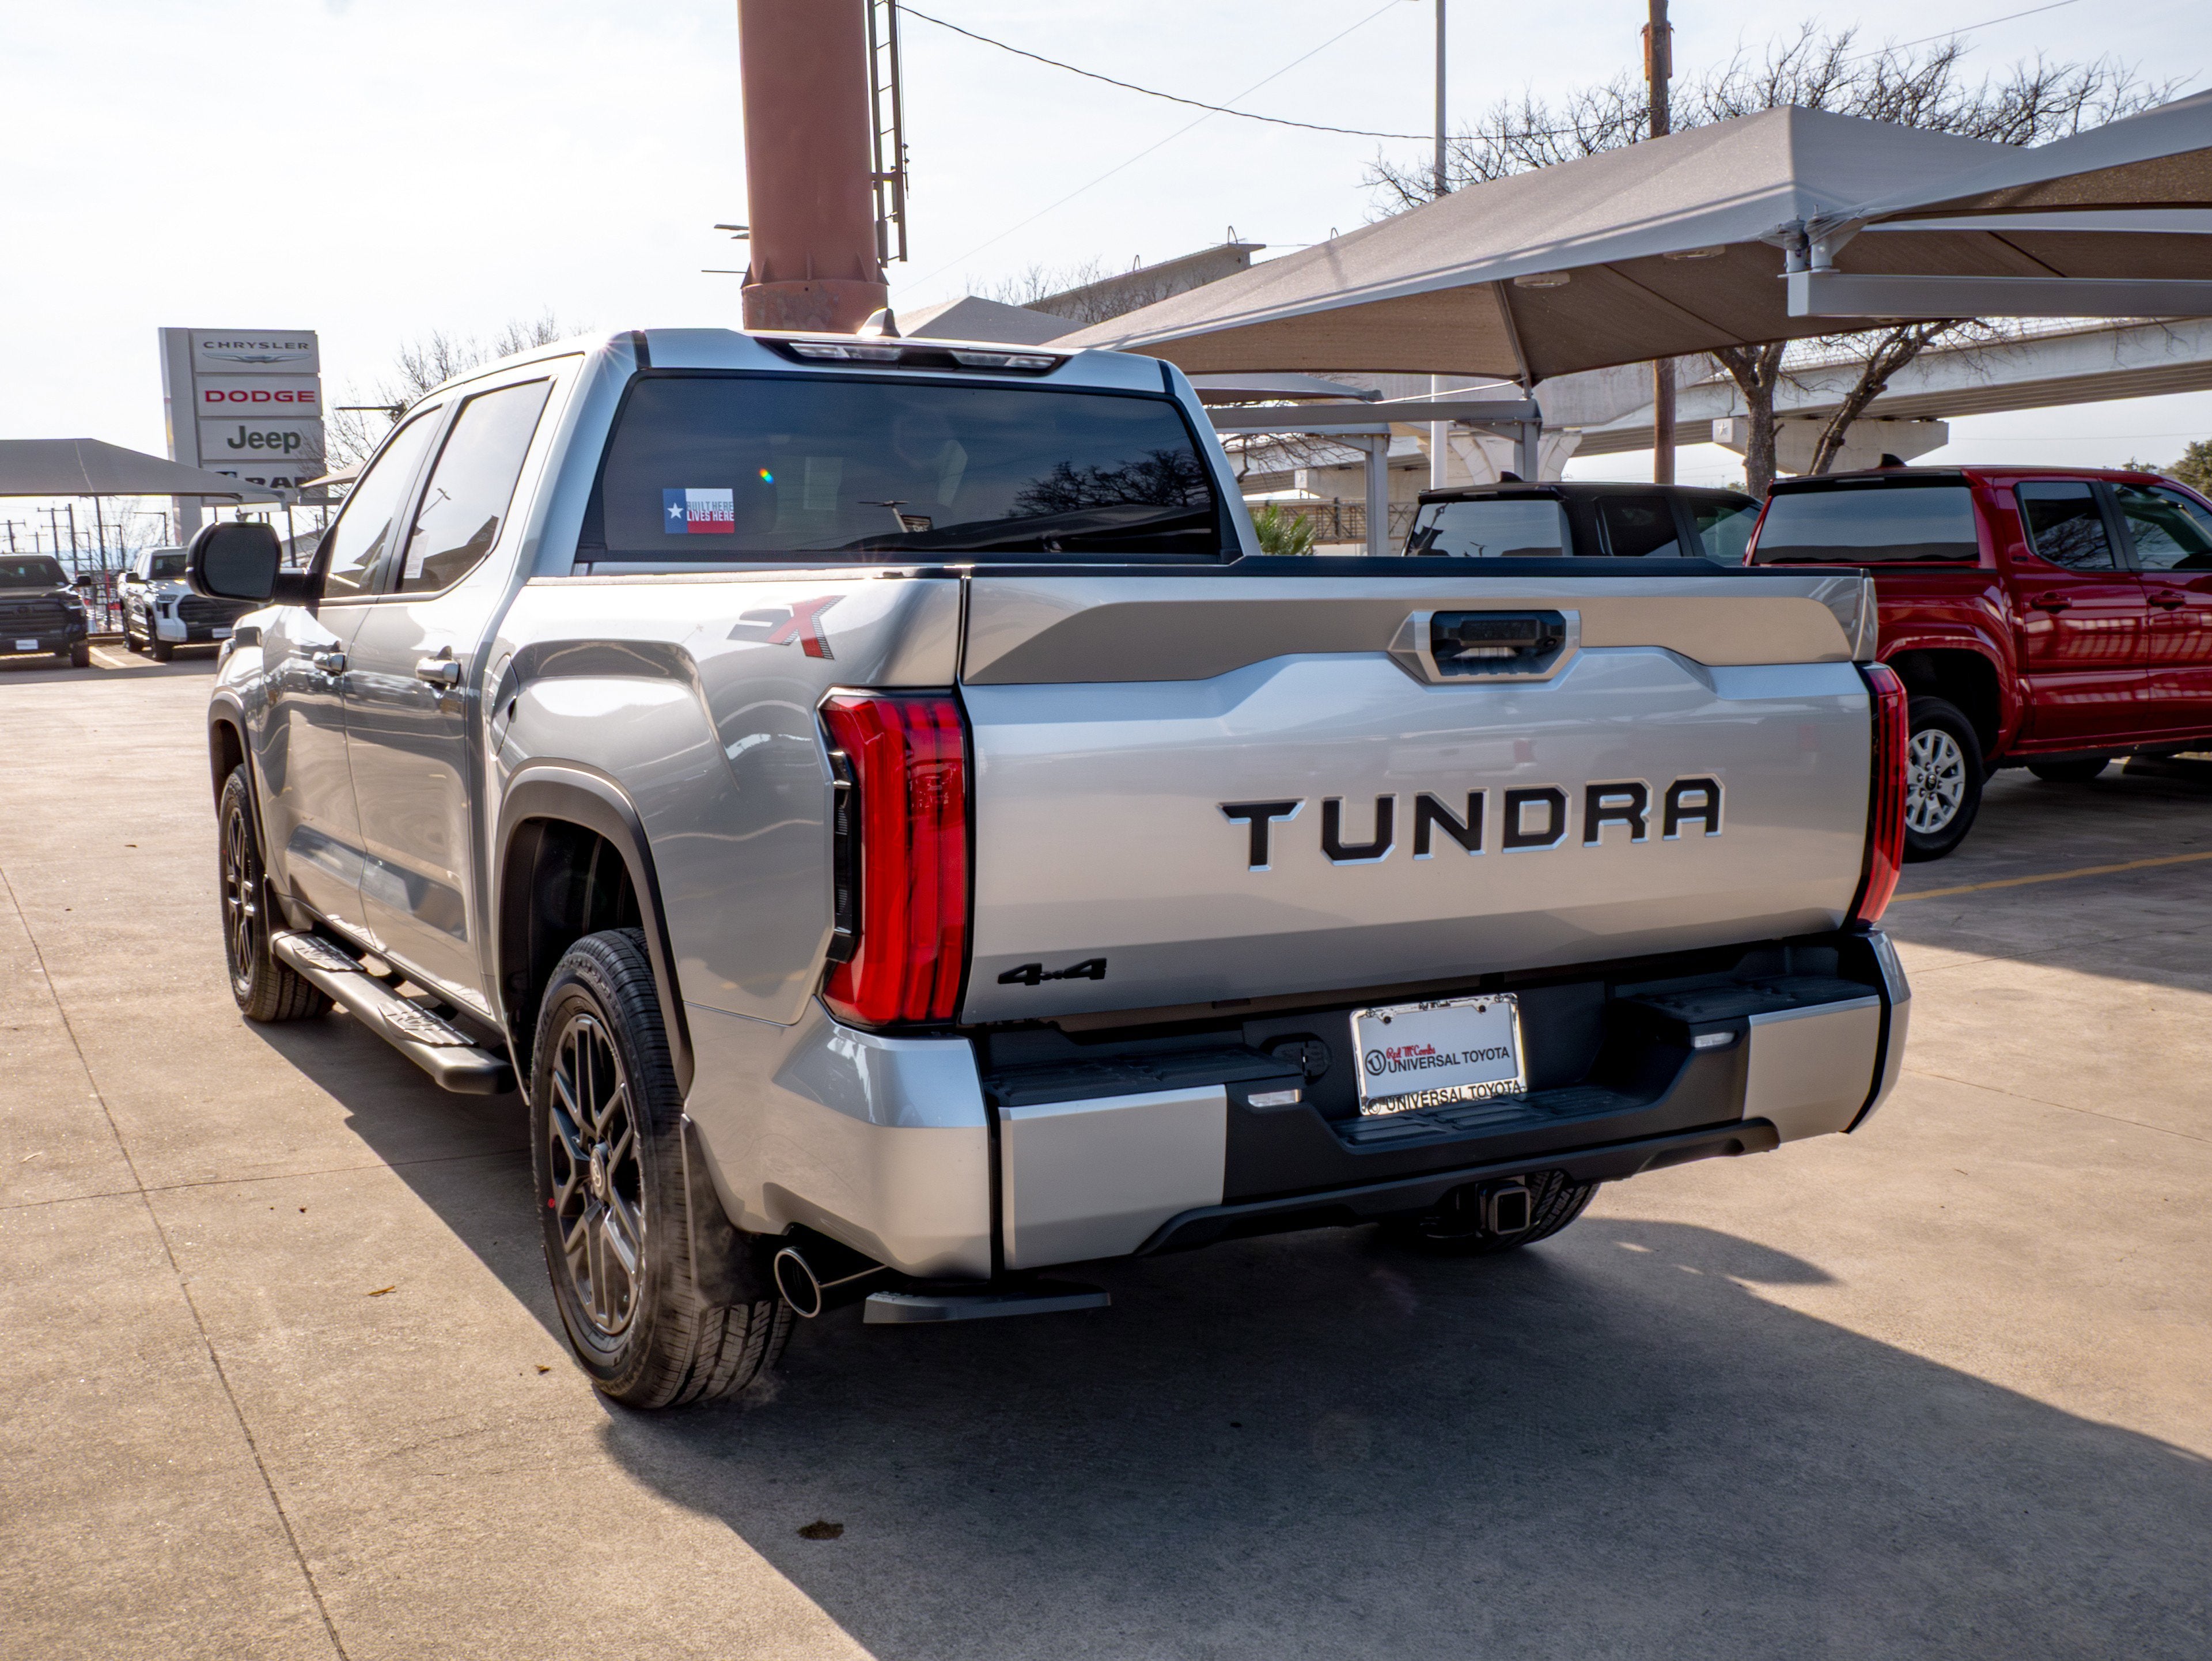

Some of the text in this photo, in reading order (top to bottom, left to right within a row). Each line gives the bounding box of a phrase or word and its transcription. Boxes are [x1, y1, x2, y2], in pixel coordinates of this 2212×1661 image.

[203, 341, 309, 349] CHRYSLER
[204, 390, 315, 402] DODGE
[227, 425, 301, 454] Jeep
[687, 501, 734, 511] BUILT HERE
[687, 510, 734, 521] LIVES HERE
[1218, 774, 1725, 872] TUNDRA
[1386, 1047, 1402, 1063] Red
[1388, 1046, 1510, 1073] UNIVERSAL TOYOTA
[1385, 1088, 1462, 1111] UNIVERSAL
[1468, 1080, 1522, 1099] TOYOTA
